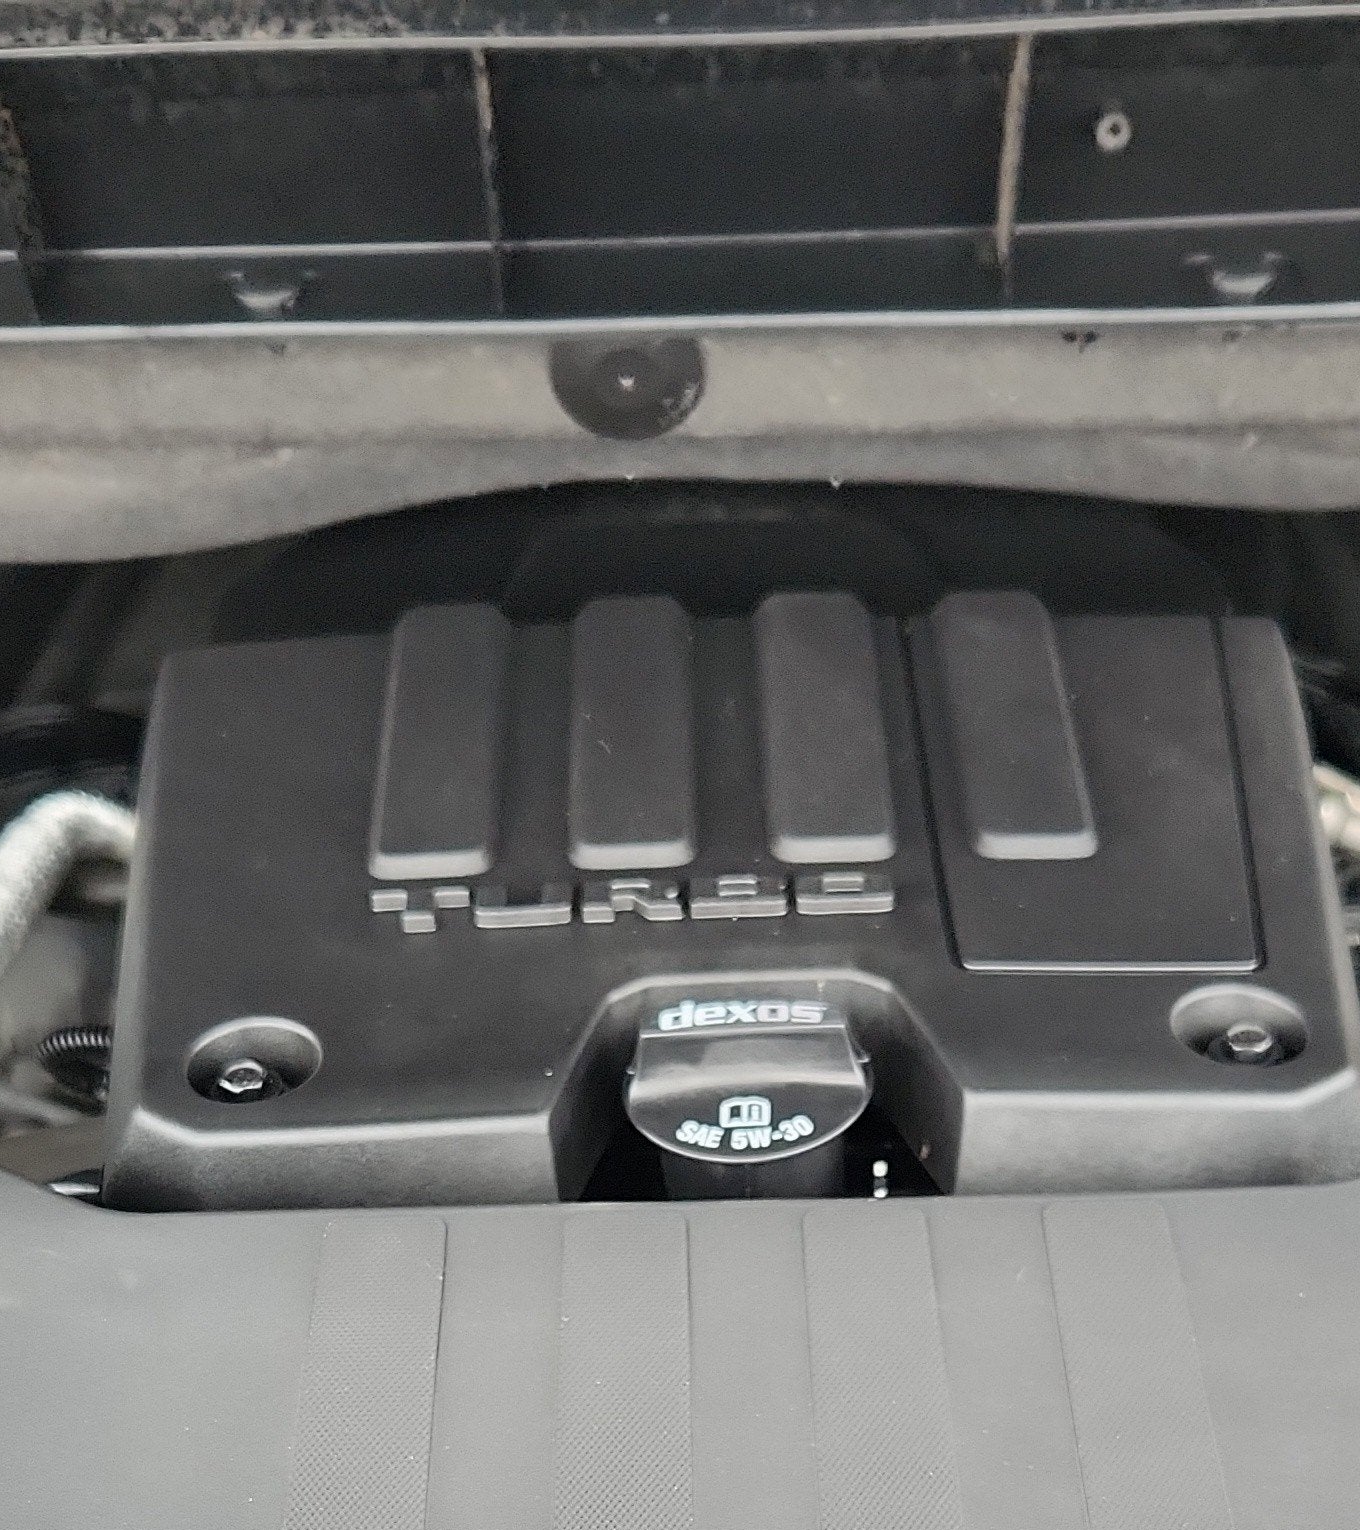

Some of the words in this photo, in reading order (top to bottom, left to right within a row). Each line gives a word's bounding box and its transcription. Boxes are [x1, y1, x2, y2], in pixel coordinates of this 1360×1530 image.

[371, 870, 894, 933] TURBO
[658, 999, 827, 1031] dexos
[675, 1119, 724, 1149] SAE
[730, 1114, 815, 1150] 5W-30
